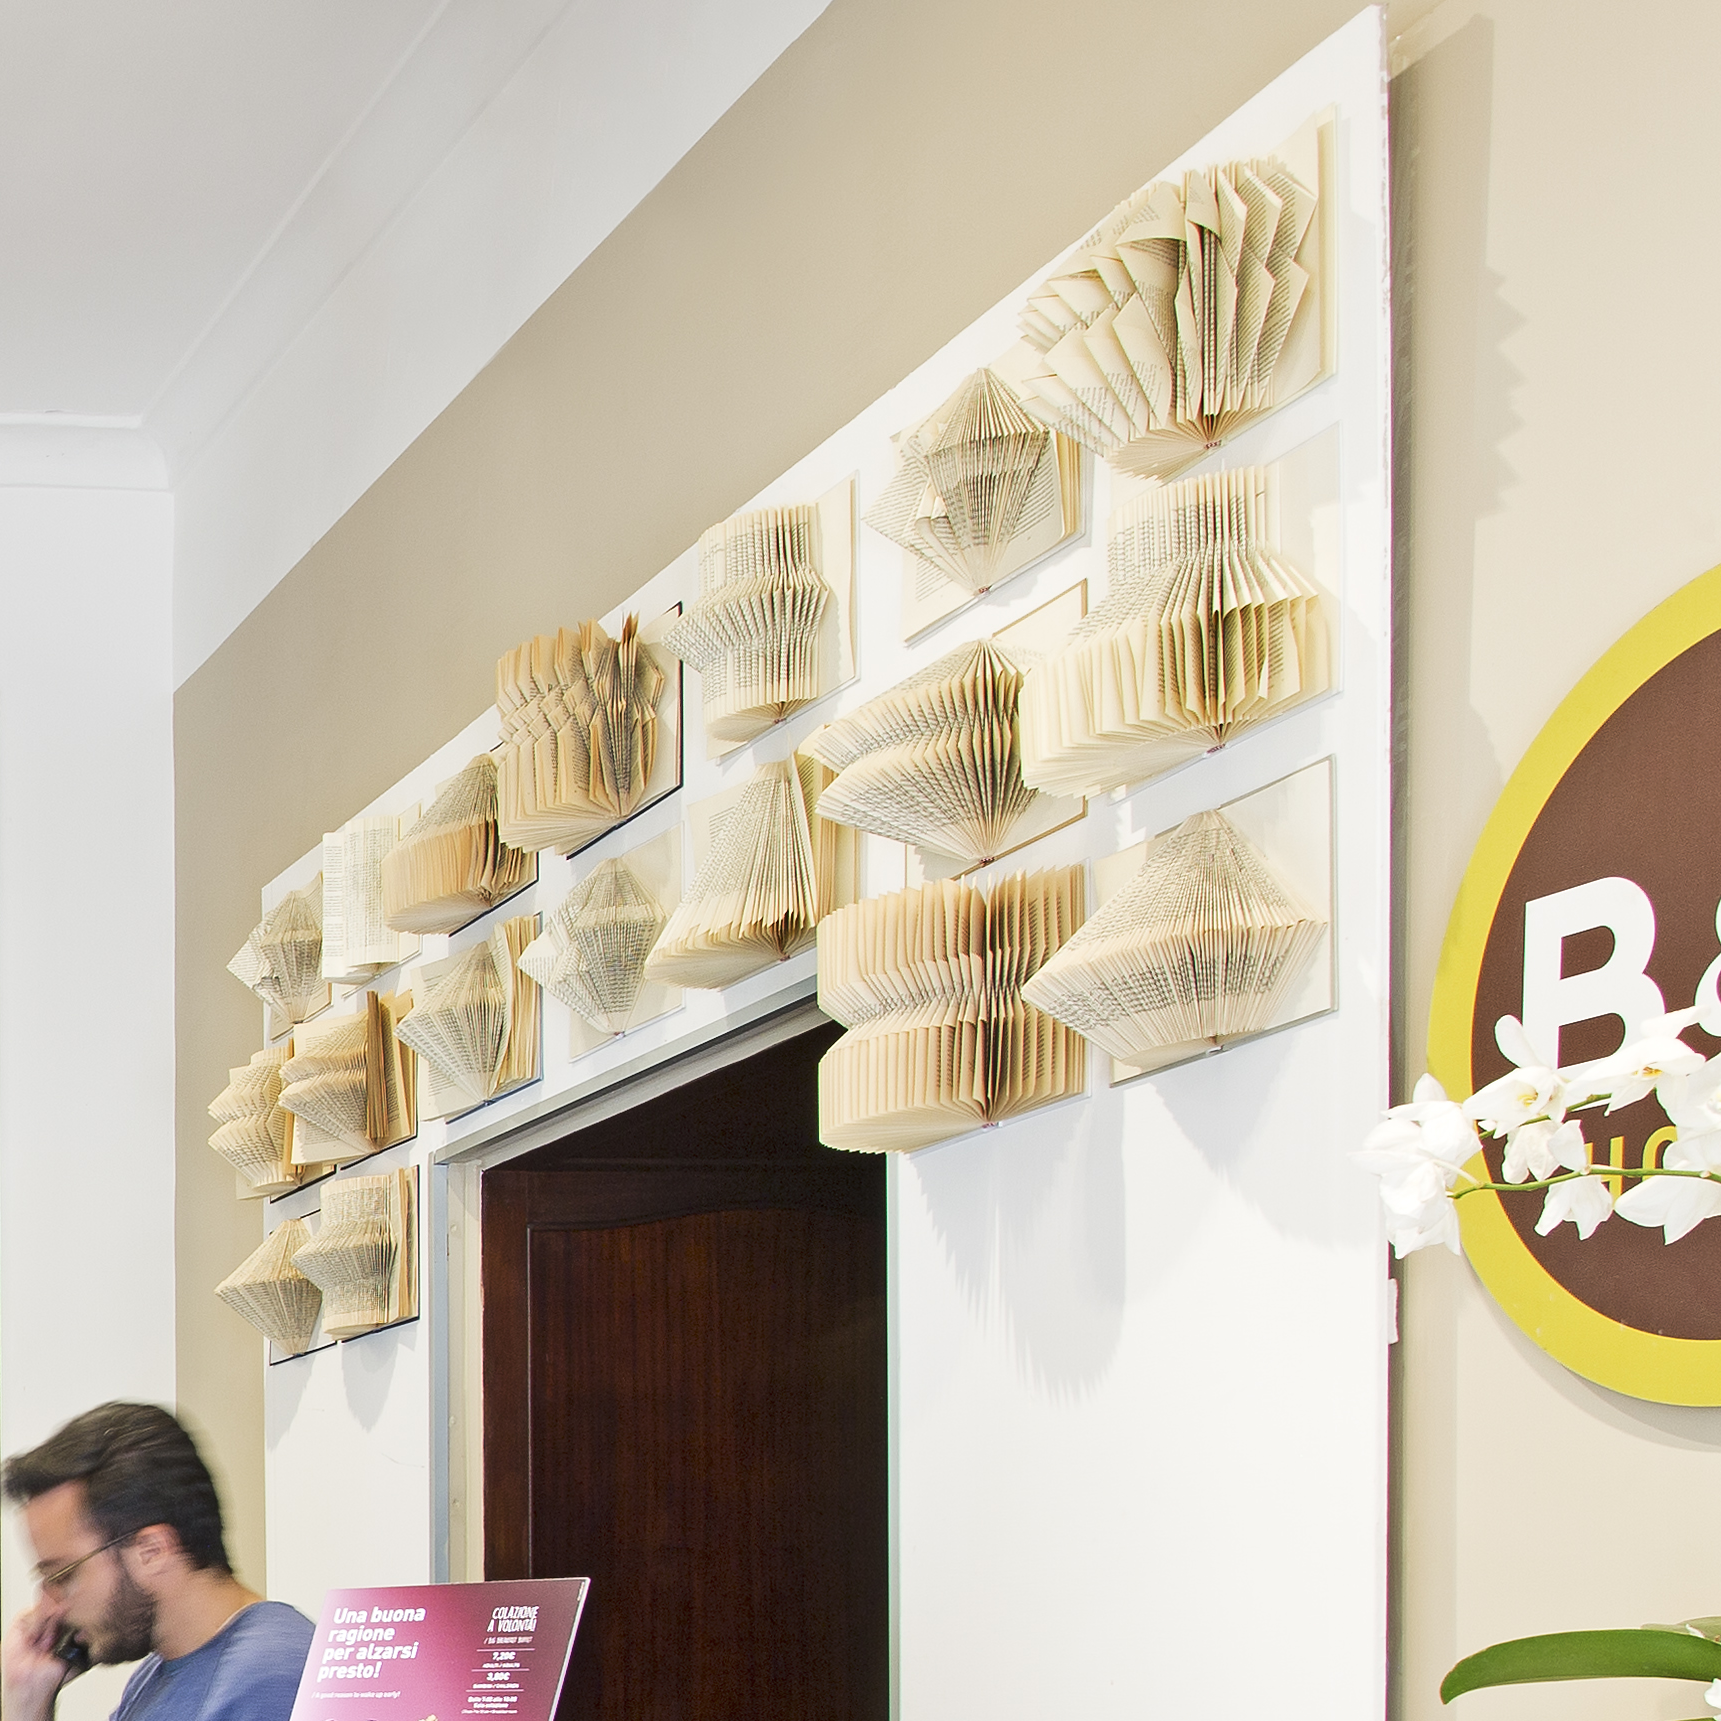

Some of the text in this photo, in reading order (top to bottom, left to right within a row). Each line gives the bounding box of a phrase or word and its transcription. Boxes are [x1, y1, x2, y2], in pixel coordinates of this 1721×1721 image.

[333, 1606, 426, 1624] Una buona
[492, 1605, 539, 1619] COLAZIONE
[327, 1624, 396, 1645] ragione
[487, 1619, 494, 1632] A
[322, 1641, 419, 1664] per alzarsi
[317, 1660, 382, 1682] presto!
